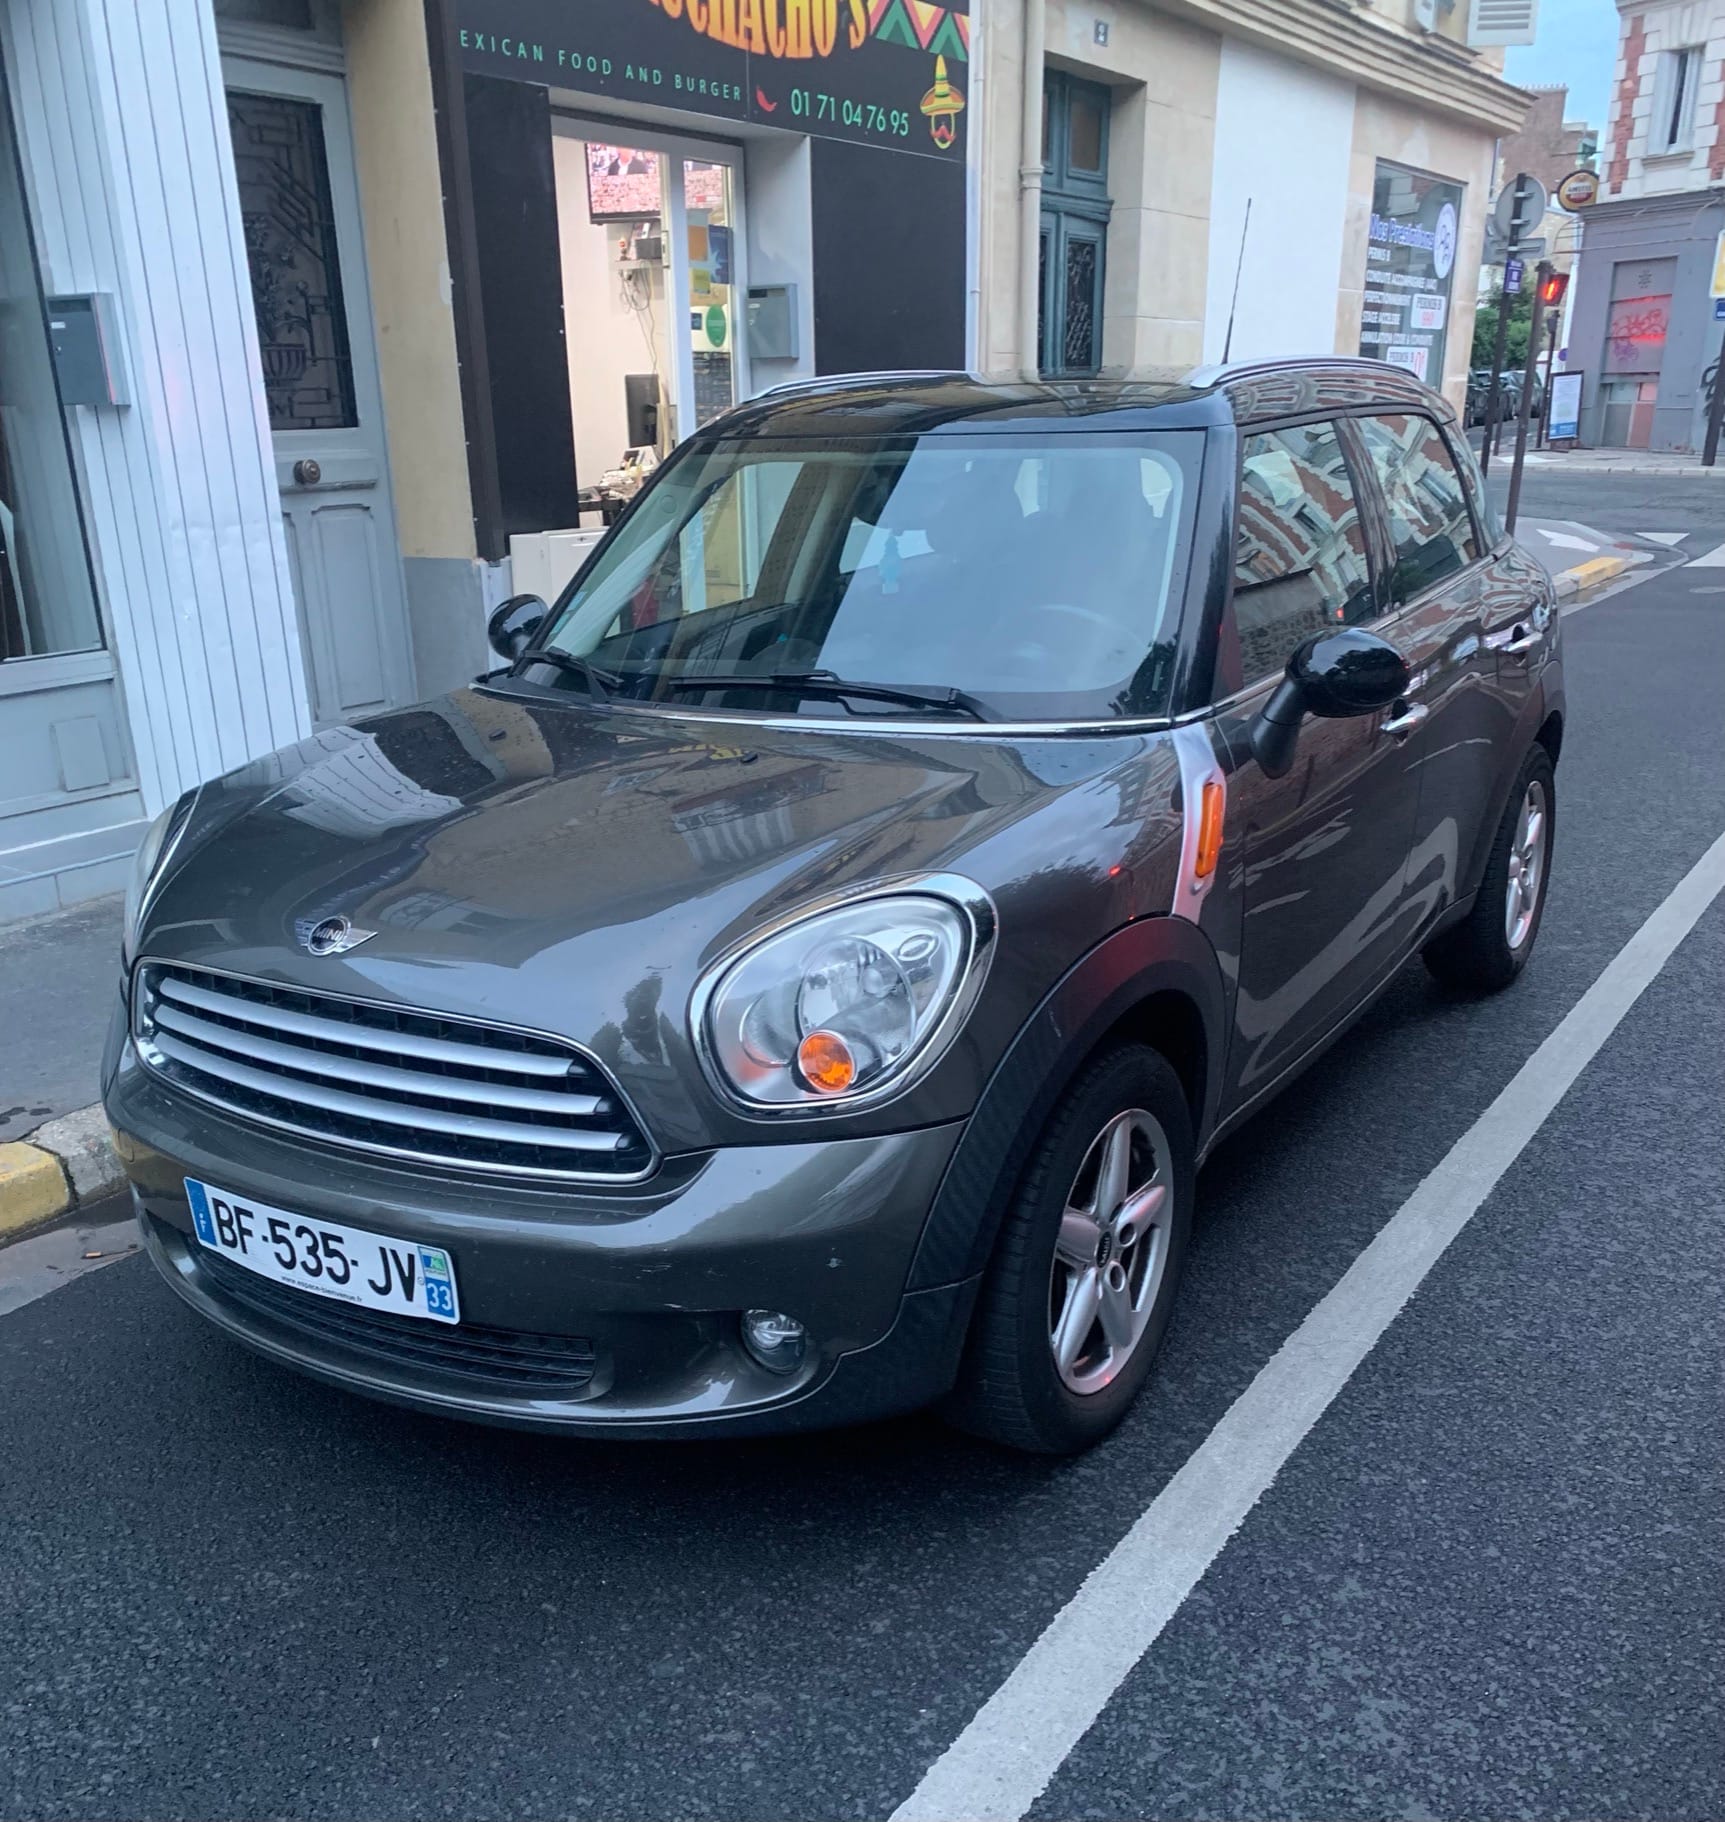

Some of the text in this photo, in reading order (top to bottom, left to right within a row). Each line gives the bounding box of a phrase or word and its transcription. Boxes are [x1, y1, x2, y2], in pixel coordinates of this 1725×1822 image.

[558, 50, 612, 75] FOOD
[625, 64, 662, 85] AND
[674, 73, 741, 101] BURGER
[791, 88, 909, 136] 01 71 04 76 95
[426, 1282, 452, 1311] 33
